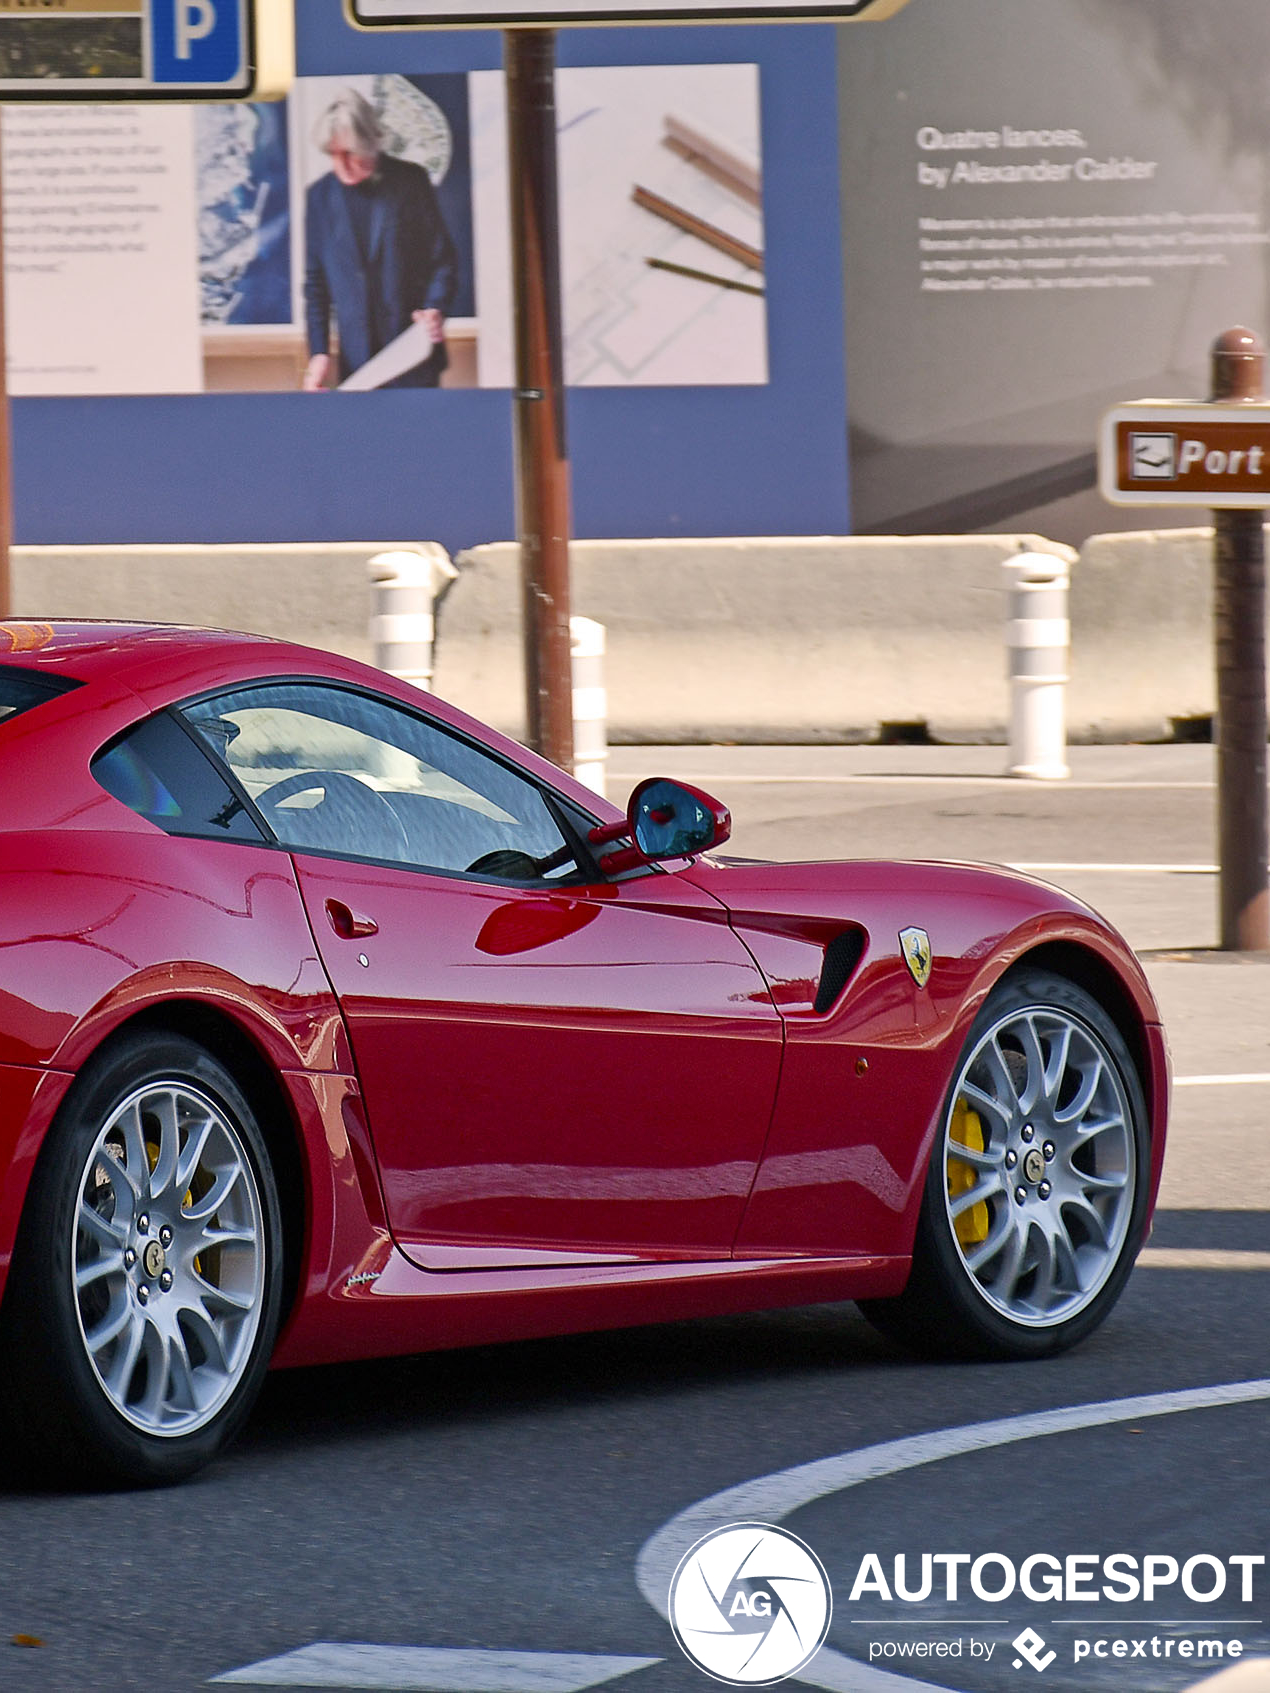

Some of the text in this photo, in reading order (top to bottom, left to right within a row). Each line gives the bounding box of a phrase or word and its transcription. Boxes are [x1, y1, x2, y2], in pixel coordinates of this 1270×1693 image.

[174, 0, 216, 60] P
[916, 127, 1000, 149] Quatre
[917, 156, 1157, 189] by Alexander Calder
[1178, 440, 1265, 474] Port
